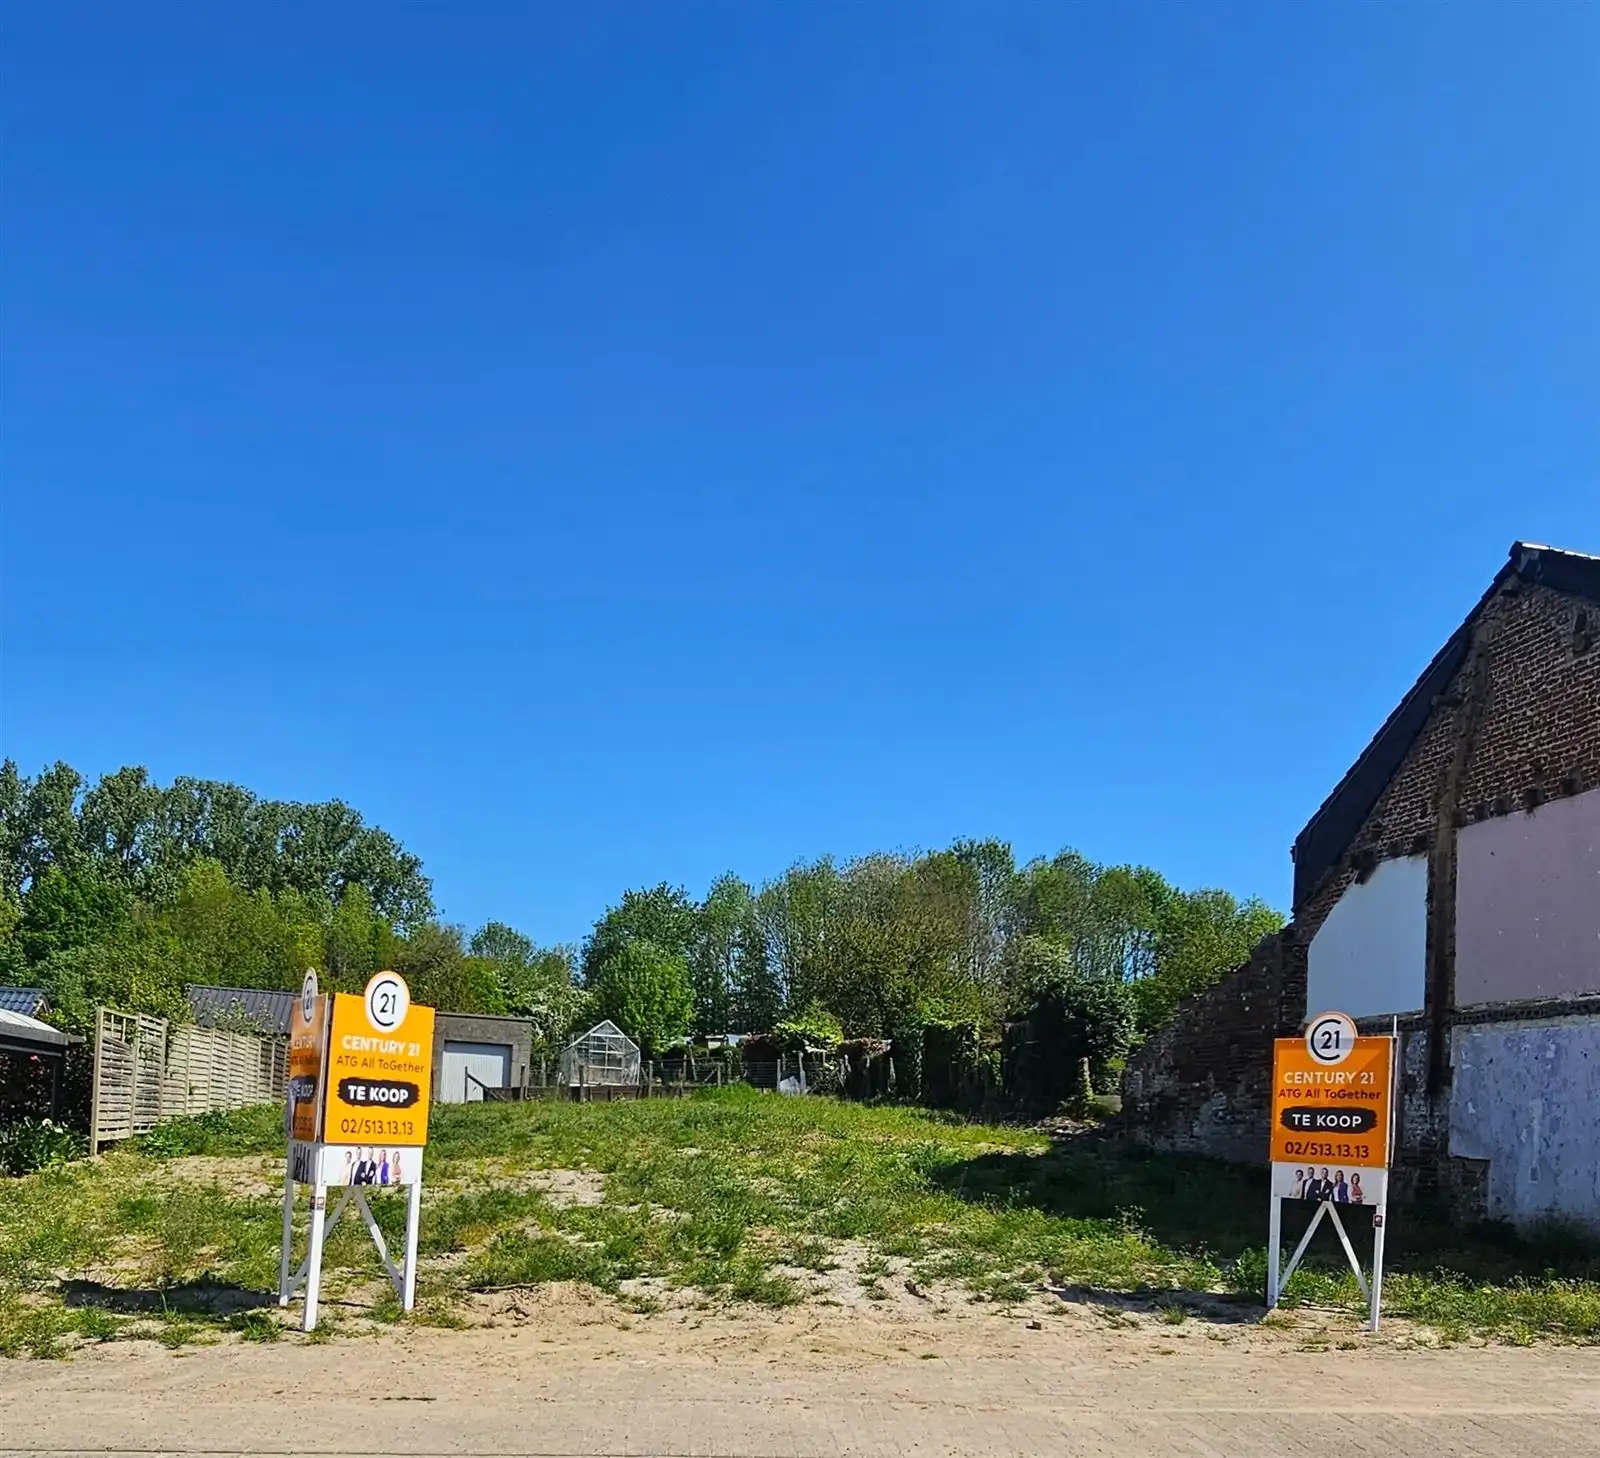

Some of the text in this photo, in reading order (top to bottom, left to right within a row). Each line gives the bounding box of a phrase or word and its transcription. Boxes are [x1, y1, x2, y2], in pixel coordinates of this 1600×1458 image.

[379, 993, 397, 1015] 21
[342, 1035, 420, 1057] CENTURY 21
[1321, 1030, 1340, 1049] 21
[336, 1056, 424, 1073] ATG All ToGether
[1284, 1071, 1374, 1084] CENTURY 21
[348, 1085, 409, 1103] TE KOOP
[1278, 1088, 1382, 1100] ATG All ToGether
[341, 1118, 414, 1135] 02/513.13.13
[1292, 1114, 1362, 1128] TE KOOP
[1284, 1141, 1369, 1158] 02/513.13.13
